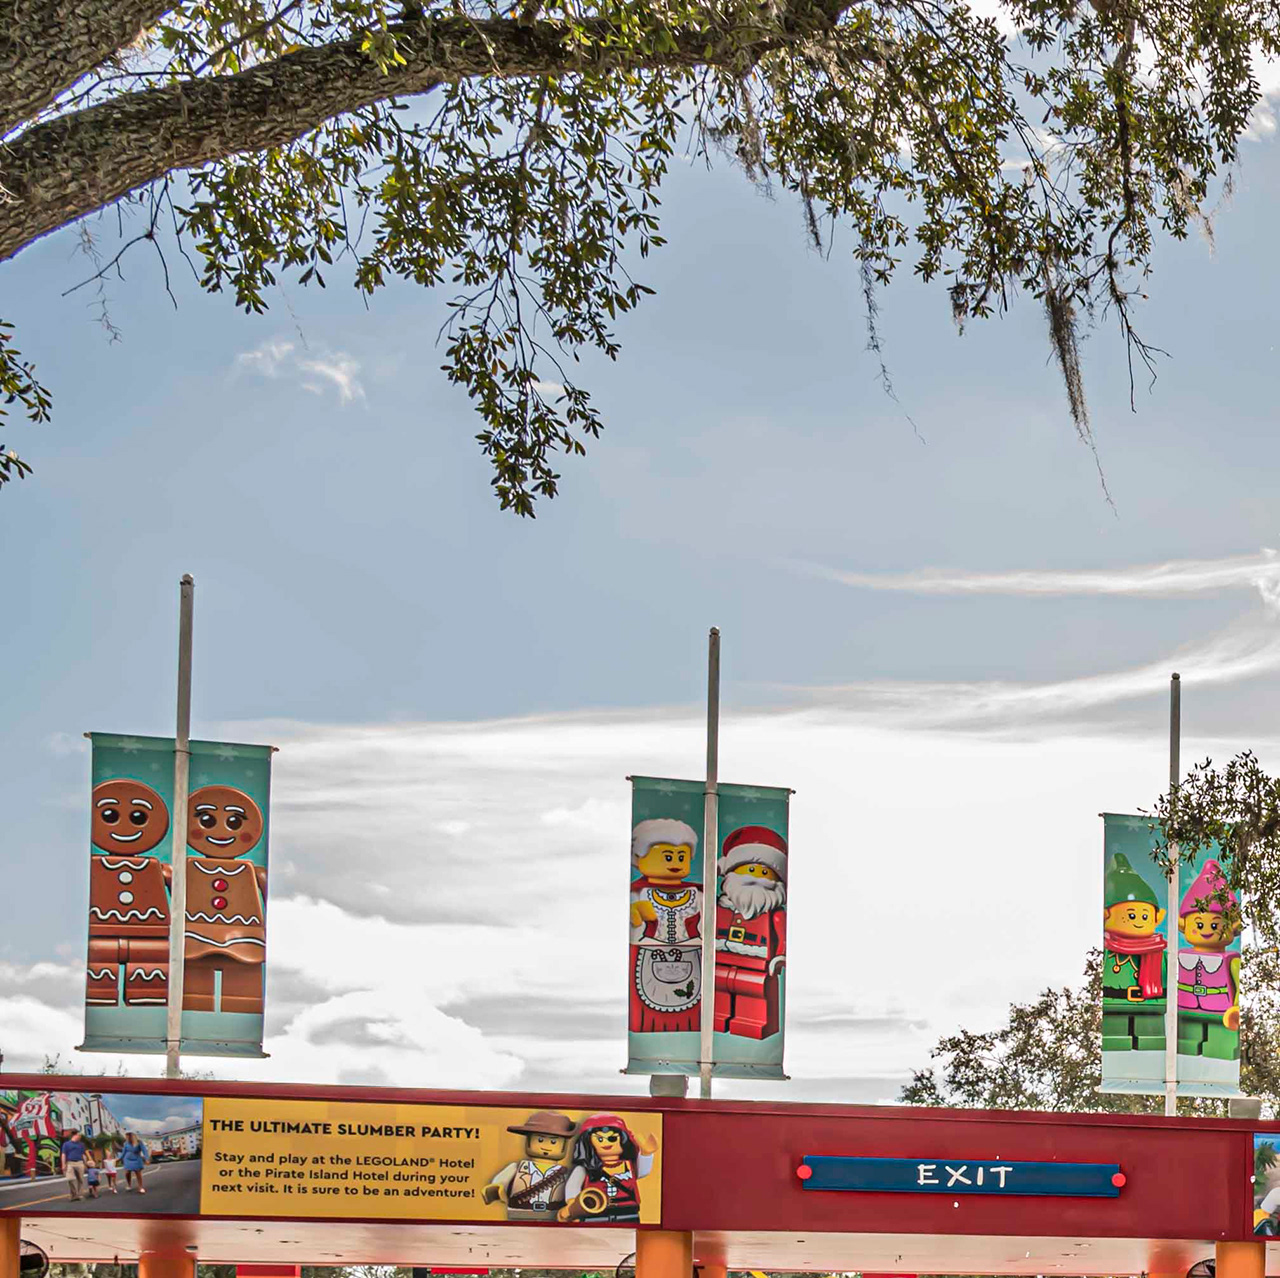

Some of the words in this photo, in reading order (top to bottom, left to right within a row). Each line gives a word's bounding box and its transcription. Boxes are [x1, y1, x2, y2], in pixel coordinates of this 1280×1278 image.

[210, 1119, 244, 1132] THE
[250, 1121, 332, 1135] ULTIMATE
[338, 1124, 415, 1137] SLUMBER
[421, 1126, 480, 1139] PARTY!
[214, 1152, 245, 1164] Stay
[249, 1153, 275, 1163] and
[279, 1154, 308, 1165] play
[311, 1155, 325, 1164] at
[330, 1155, 352, 1165] the
[439, 1158, 474, 1168] Hotel
[219, 1169, 234, 1177] or
[238, 1167, 261, 1177] the
[265, 1168, 305, 1179] Pirate
[309, 1169, 348, 1180] Island
[353, 1171, 388, 1181] Hotel
[393, 1171, 436, 1184] during
[440, 1175, 469, 1184] your
[917, 1163, 1013, 1188] EXIT
[212, 1183, 242, 1192] next
[247, 1182, 279, 1194] visit.
[283, 1184, 293, 1194] It
[297, 1183, 308, 1194] is
[312, 1186, 340, 1195] sure
[344, 1186, 358, 1195] to
[363, 1185, 379, 1196] be
[383, 1187, 399, 1196] an
[403, 1186, 475, 1198] adventure!
